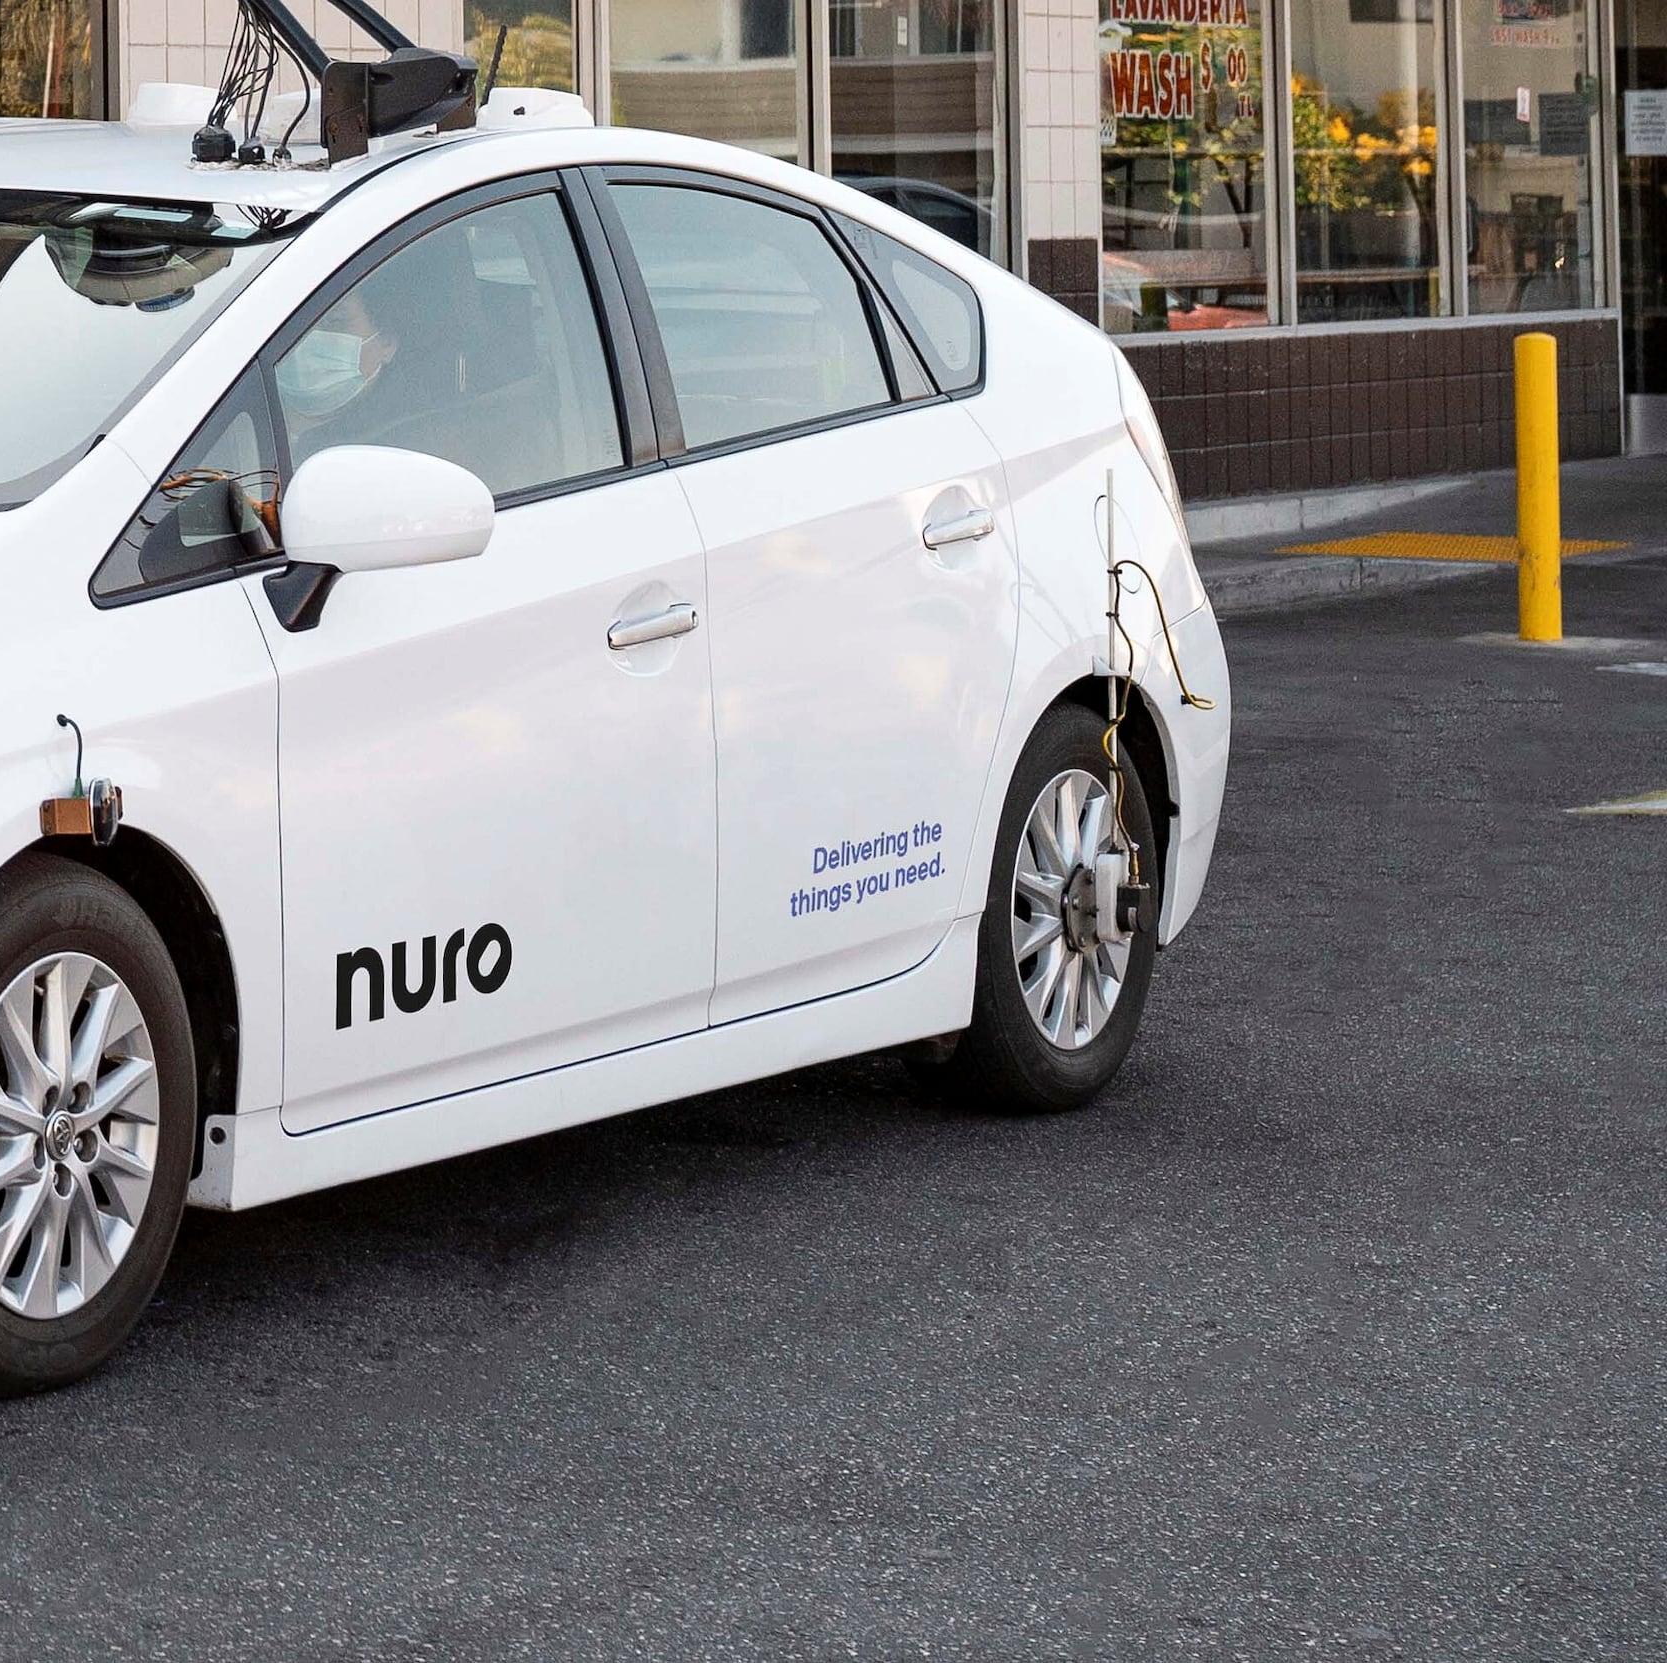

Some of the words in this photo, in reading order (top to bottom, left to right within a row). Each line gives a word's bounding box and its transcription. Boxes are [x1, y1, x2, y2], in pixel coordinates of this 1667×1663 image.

[1110, 48, 1194, 119] WASH
[1226, 47, 1248, 87] 00
[813, 830, 909, 874] Delivering
[912, 820, 942, 847] the
[790, 882, 852, 917] things
[856, 871, 889, 904] you
[895, 851, 946, 888] need.
[336, 922, 512, 1030] nuro
